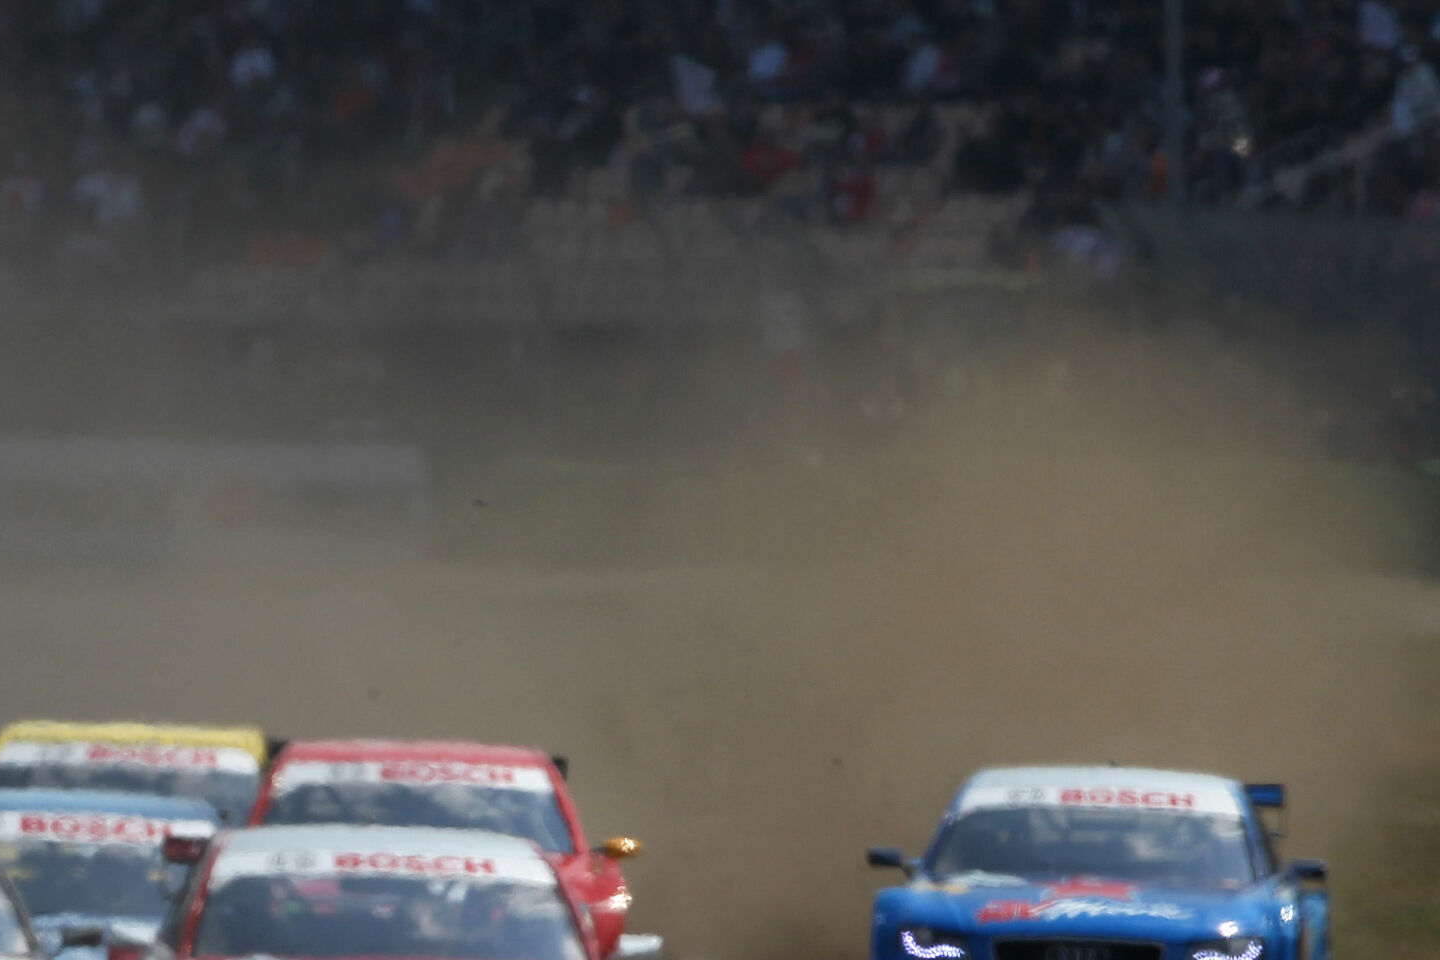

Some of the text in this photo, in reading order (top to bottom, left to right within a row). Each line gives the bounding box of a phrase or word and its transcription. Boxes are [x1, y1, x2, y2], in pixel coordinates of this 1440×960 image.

[1061, 788, 1195, 808] BOSCH
[21, 815, 171, 839] BOSCH
[335, 854, 494, 874] BOSCH
